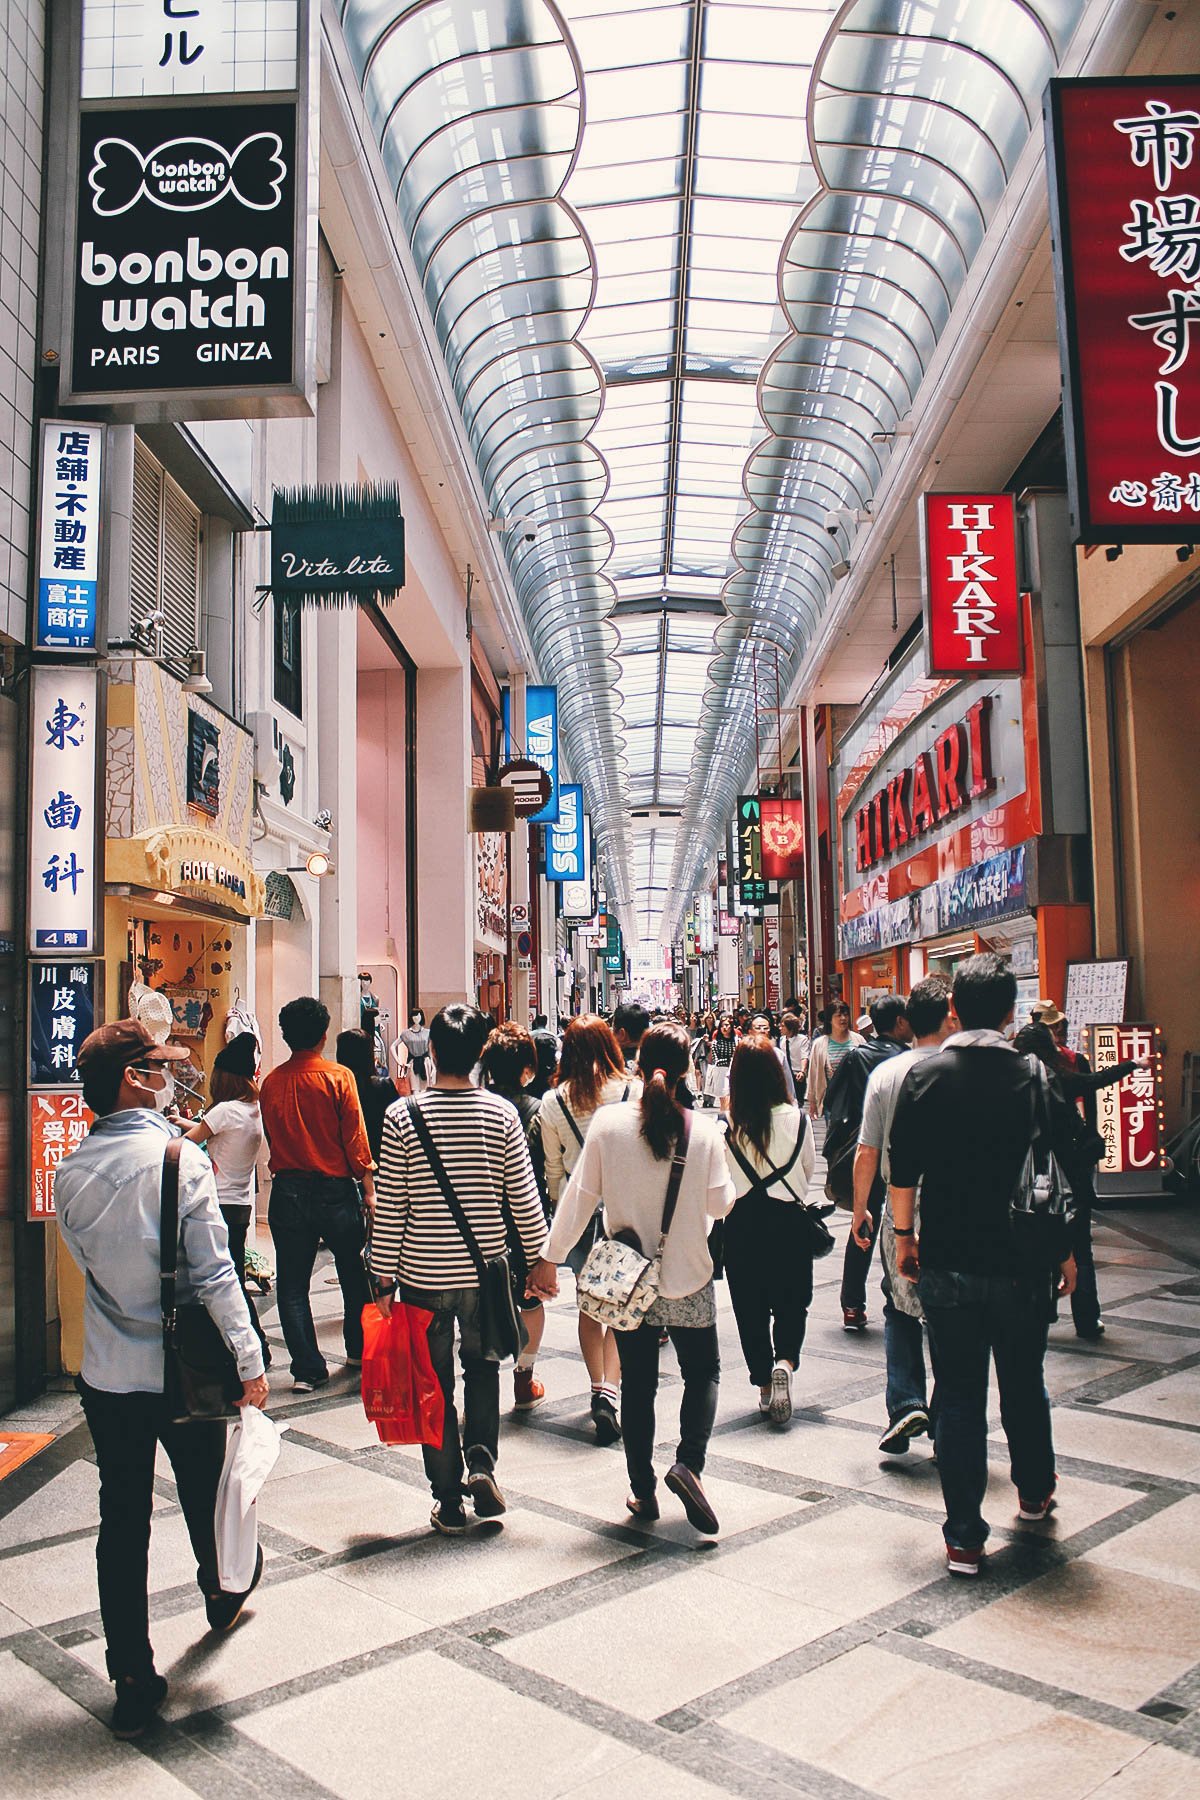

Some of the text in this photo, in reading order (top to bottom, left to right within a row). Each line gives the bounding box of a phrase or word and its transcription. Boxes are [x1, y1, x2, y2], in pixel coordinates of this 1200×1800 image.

[151, 159, 225, 178] bonbon
[158, 175, 217, 193] watch
[81, 237, 289, 286] bonbon
[1114, 102, 1200, 456] 市場ずし
[102, 282, 265, 333] watch
[91, 341, 272, 367] PARIS GINZA
[53, 432, 90, 571] 店舗・不動産
[281, 553, 394, 578] Vita lita
[946, 504, 1001, 662] HIKARI
[47, 584, 89, 604] 富士
[47, 608, 89, 628] 商行
[74, 636, 90, 647] 1F
[42, 698, 84, 896] 東歯科
[855, 697, 997, 873] HIKARI
[552, 792, 578, 873] SEGA
[44, 932, 79, 945] 4階
[51, 986, 76, 1069] 皮膚科
[1119, 1027, 1156, 1168] 市場ずし
[43, 1121, 66, 1167] 受付
